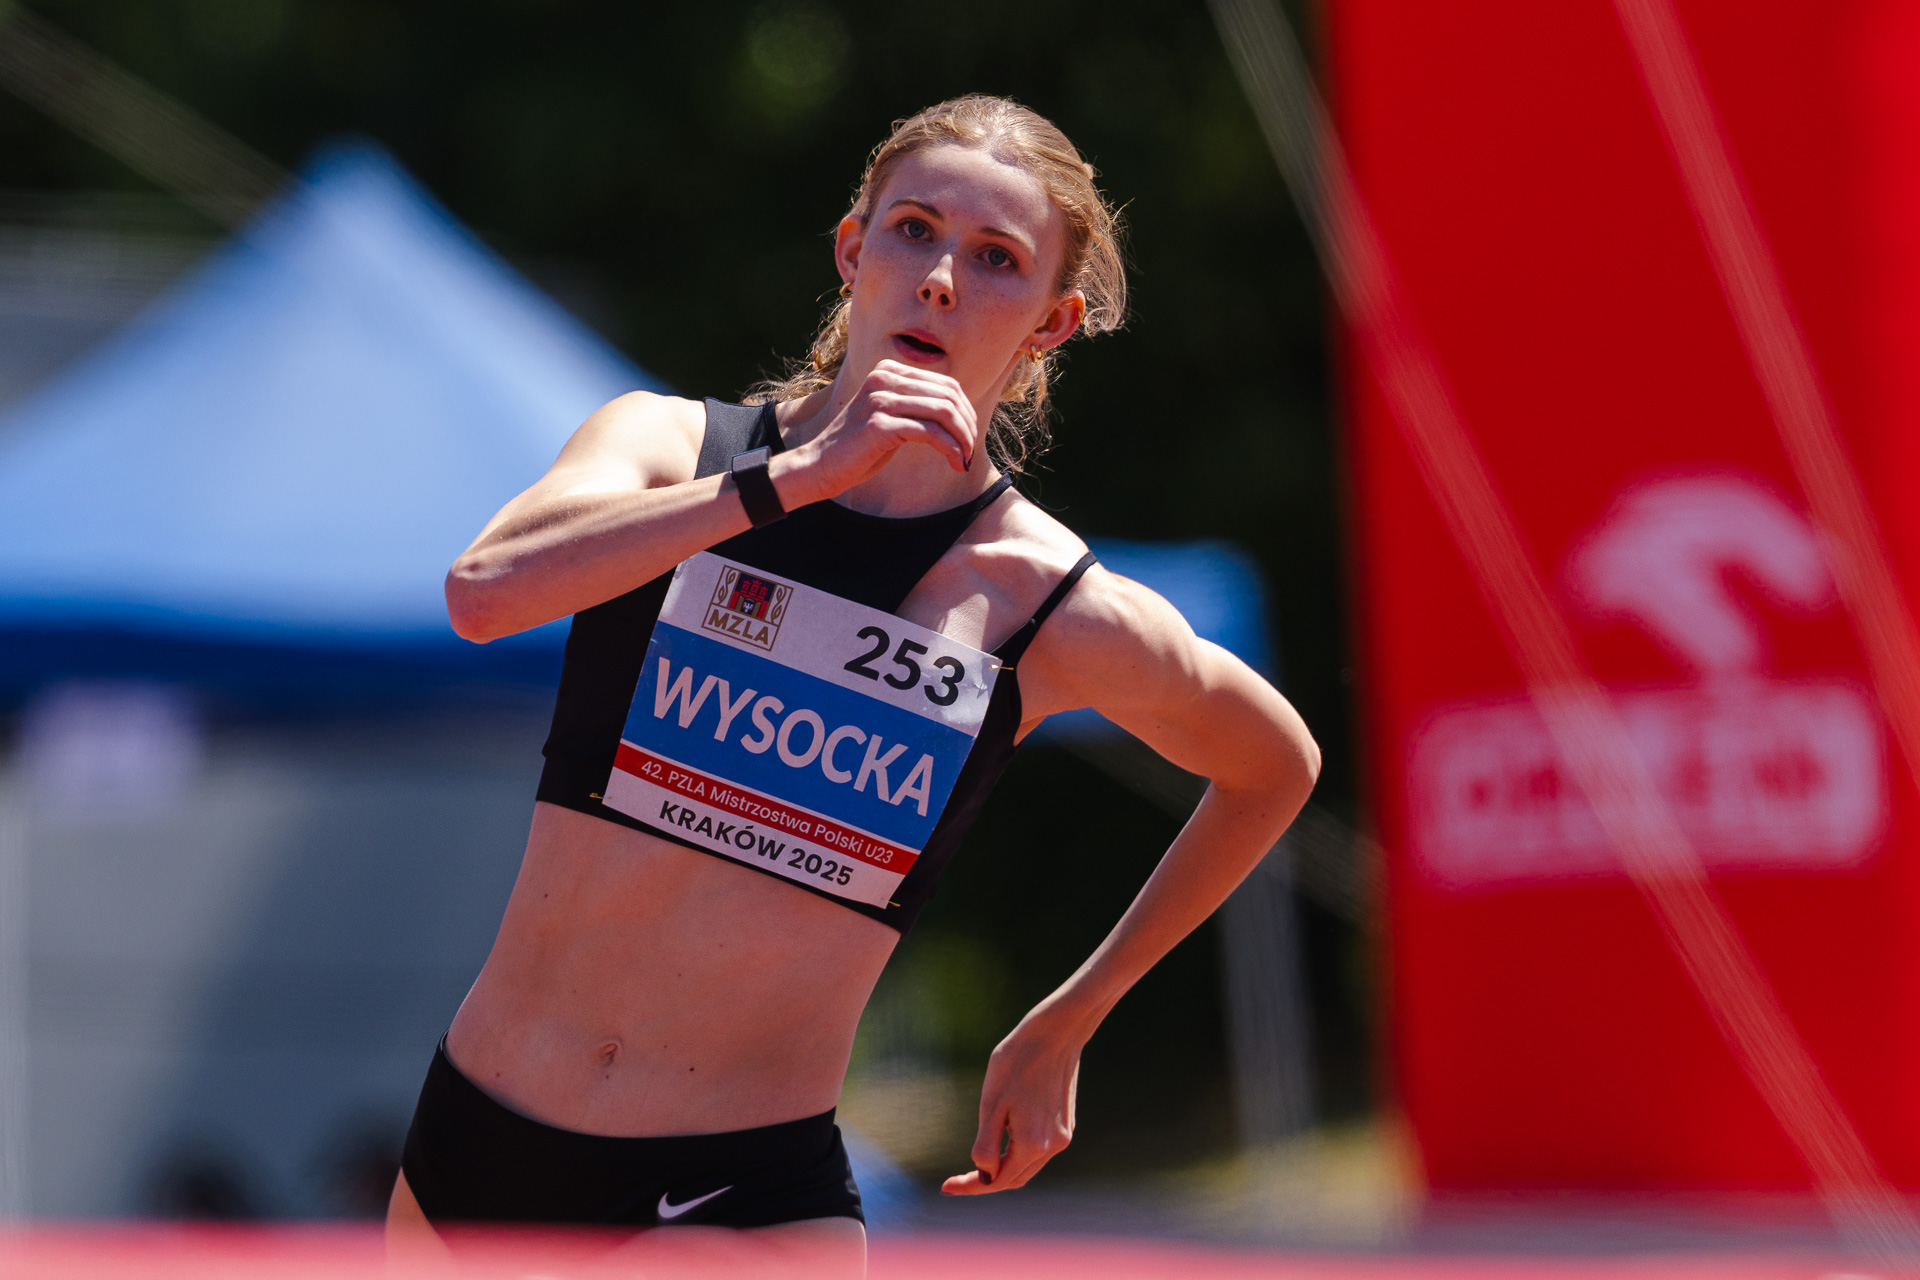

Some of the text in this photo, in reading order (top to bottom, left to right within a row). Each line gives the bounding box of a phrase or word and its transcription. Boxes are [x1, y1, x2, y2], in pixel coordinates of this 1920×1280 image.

[708, 608, 770, 647] MZLA
[843, 625, 966, 707] 253
[653, 656, 935, 818] WYSOCKA
[641, 760, 895, 864] 42. PZLA Mistrzostwa Polski U23
[659, 800, 854, 886] KRAKÓW 2025
